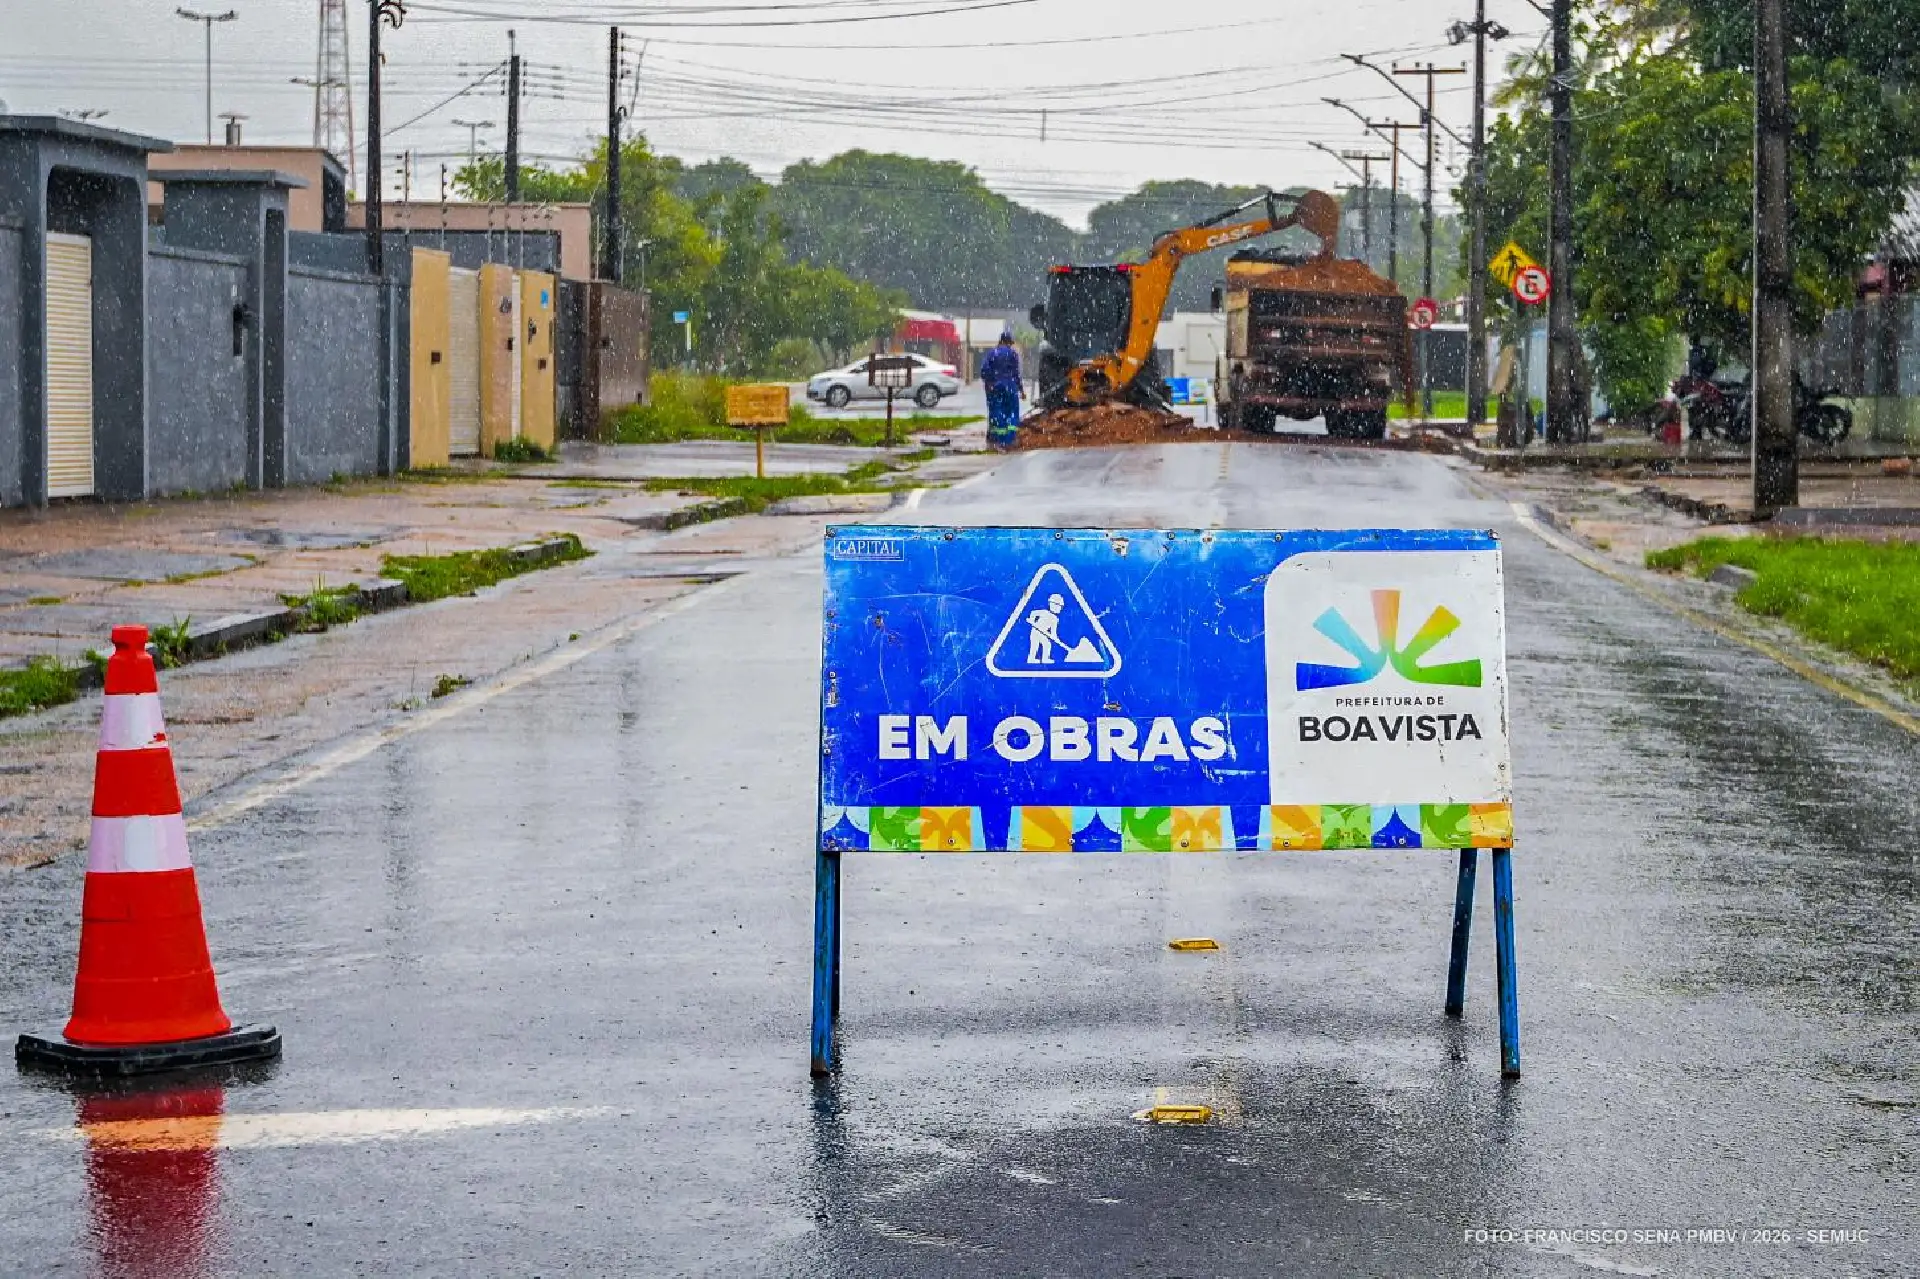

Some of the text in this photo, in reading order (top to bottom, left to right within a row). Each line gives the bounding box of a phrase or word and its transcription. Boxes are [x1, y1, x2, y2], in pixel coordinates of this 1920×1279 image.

[837, 540, 900, 554] CAPITAL
[878, 715, 1227, 762] EM OBRAS
